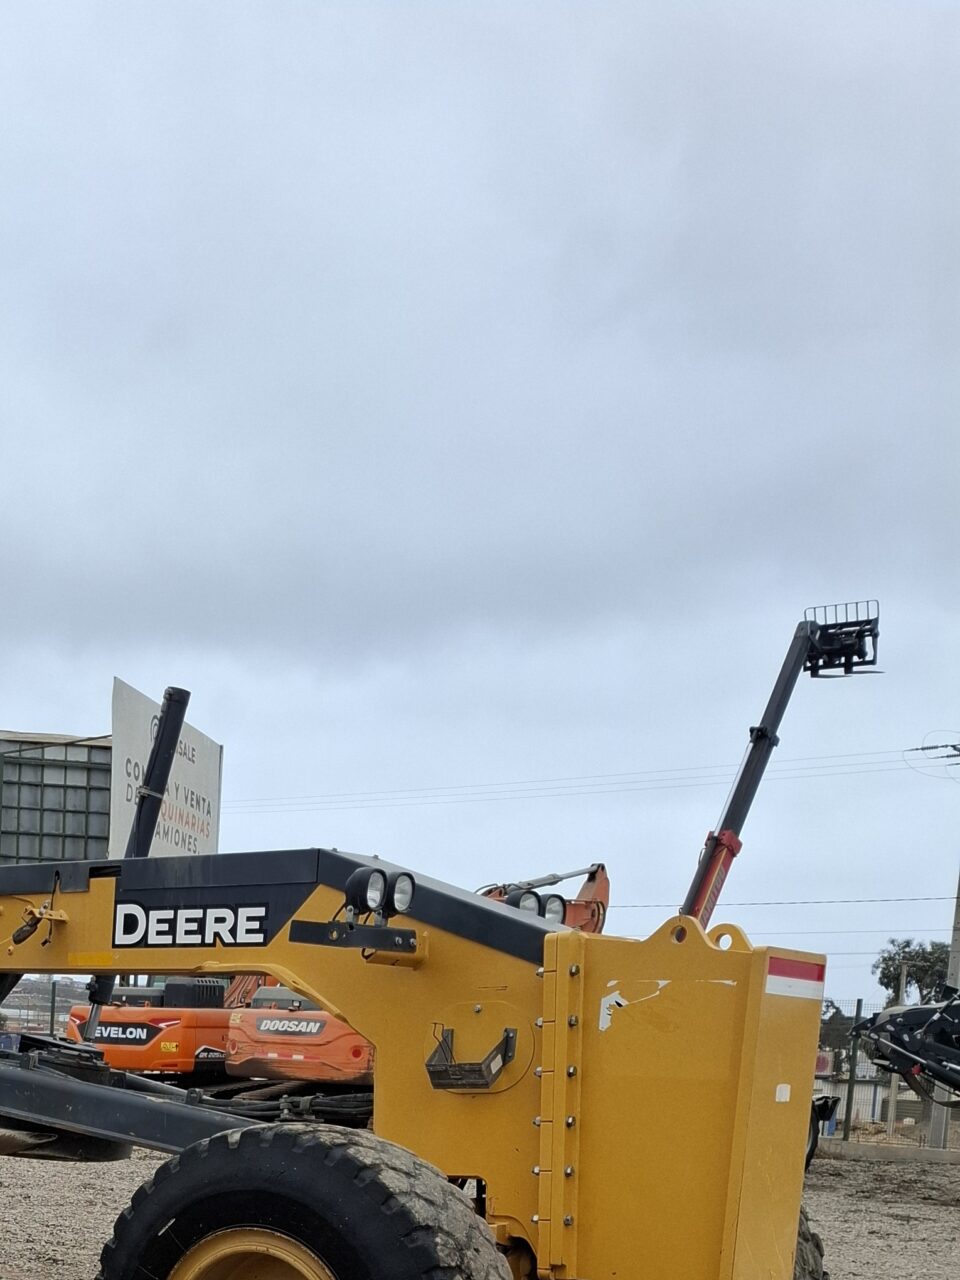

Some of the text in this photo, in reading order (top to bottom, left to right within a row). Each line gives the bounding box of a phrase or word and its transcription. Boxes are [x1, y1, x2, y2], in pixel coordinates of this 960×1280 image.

[174, 781, 181, 801] Y
[183, 785, 212, 819] VENTA
[154, 820, 200, 856] AMIONES.
[159, 800, 211, 840] QUINARIAS
[115, 904, 266, 944] DEERE
[95, 1026, 147, 1039] EVELON
[260, 1019, 321, 1034] DOOSAN
